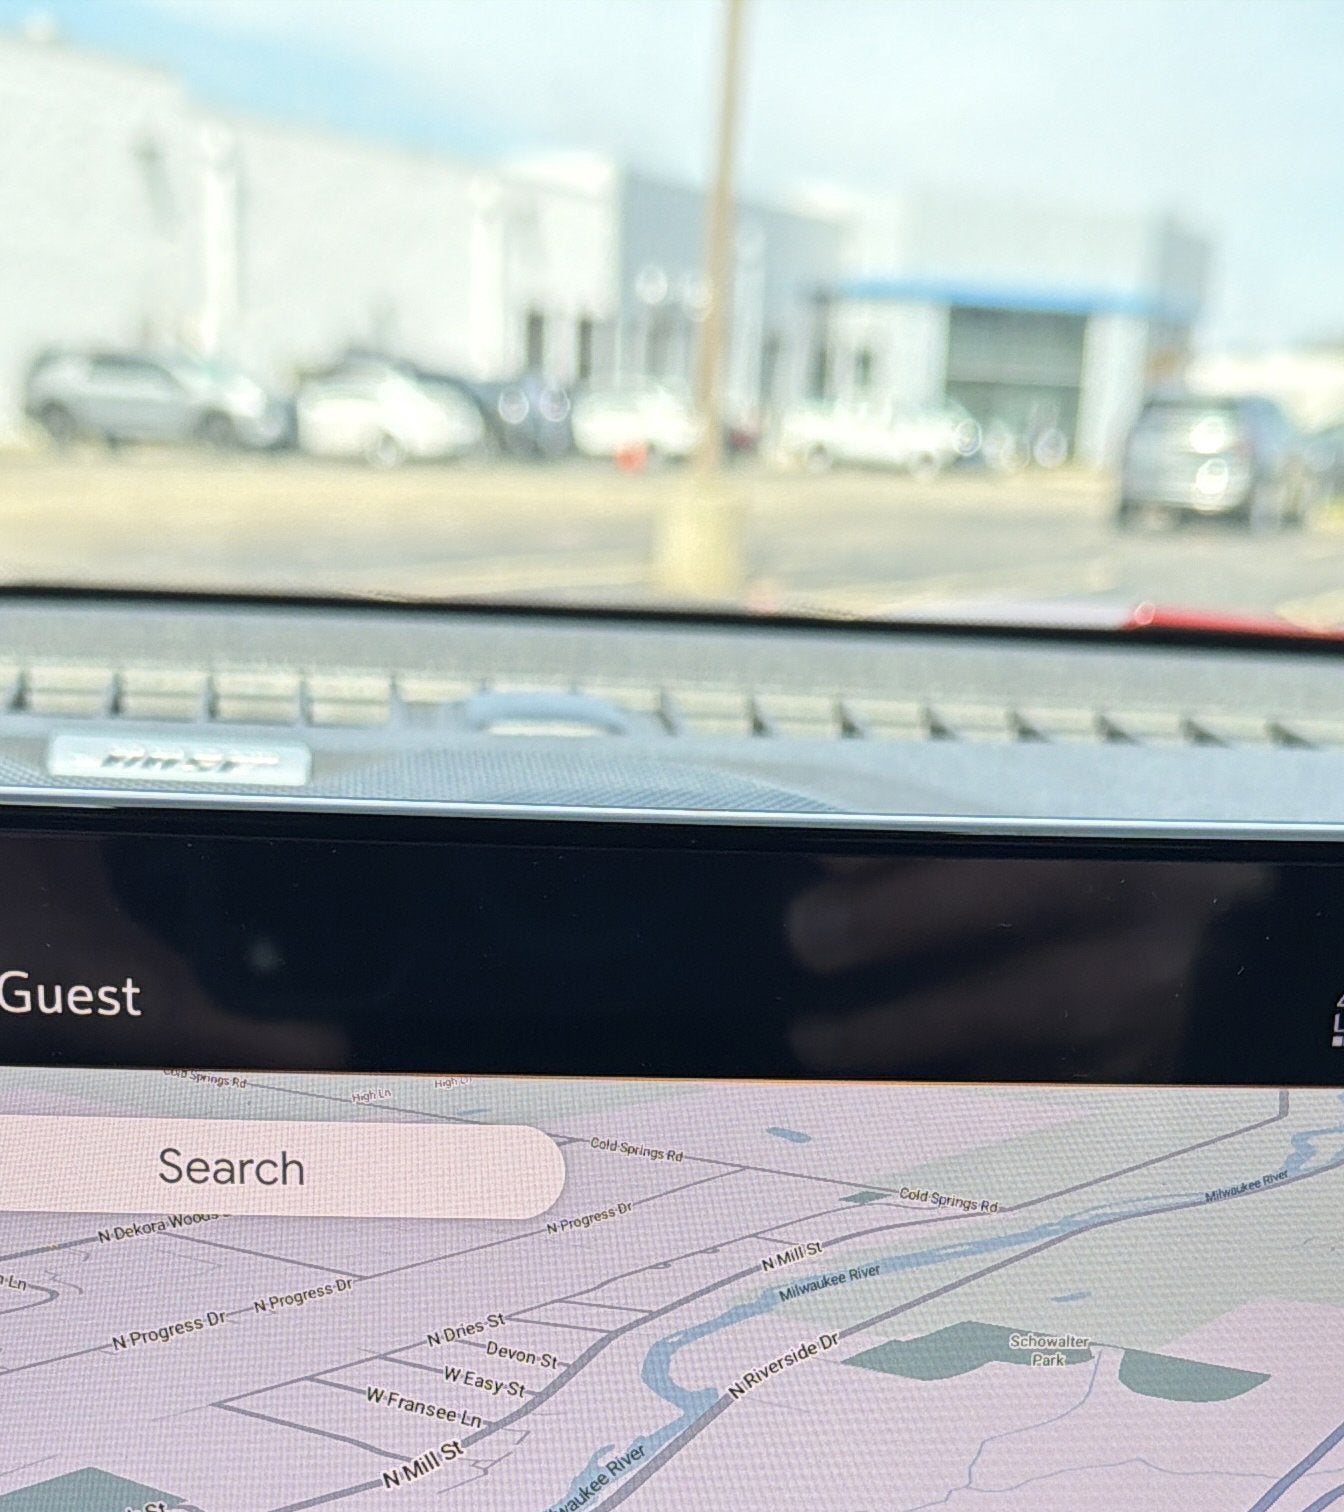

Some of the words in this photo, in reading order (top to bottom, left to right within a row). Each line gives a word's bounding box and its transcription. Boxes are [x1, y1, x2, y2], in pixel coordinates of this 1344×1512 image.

[190, 1070, 229, 1087] Springs
[232, 1077, 247, 1088] Rd
[591, 1137, 617, 1152] Cold
[620, 1142, 664, 1160] Springs
[666, 1150, 683, 1162] Rd
[159, 1147, 305, 1186] Search
[900, 1187, 928, 1204] Cold
[931, 1192, 978, 1212] Springs
[981, 1200, 997, 1213] Rd
[1205, 1178, 1261, 1203] Milwaukee
[1262, 1169, 1288, 1187] River
[98, 1230, 111, 1244] N
[113, 1219, 166, 1241] Dekora
[546, 1223, 558, 1235] N
[560, 1207, 616, 1232] Progress
[617, 1202, 632, 1215] Dr
[762, 1259, 775, 1272] N
[777, 1246, 805, 1268] Mill
[806, 1241, 822, 1256] St
[8, 1275, 27, 1291] Ln
[254, 1300, 267, 1313] N
[269, 1283, 334, 1310] Progress
[336, 1277, 353, 1292] Dr
[778, 1272, 846, 1302] Milwaukee
[848, 1264, 881, 1282] River
[112, 1336, 128, 1351] N
[130, 1317, 205, 1347] Progress
[207, 1310, 226, 1327] Dr
[427, 1332, 441, 1347] N
[443, 1321, 484, 1342] Dries
[487, 1313, 506, 1328] St
[1009, 1334, 1090, 1349] Schowalter
[486, 1340, 536, 1364] Devon
[540, 1353, 558, 1369] St
[728, 1383, 744, 1400] N
[741, 1344, 818, 1391] Riverside
[818, 1331, 840, 1351] Dr
[1032, 1353, 1064, 1367] Park
[444, 1366, 461, 1382] W
[463, 1371, 504, 1396] Easy
[506, 1381, 526, 1398] St
[367, 1386, 386, 1403] W
[387, 1392, 457, 1423] Fransee
[460, 1411, 482, 1429] Ln
[382, 1471, 400, 1489] N
[401, 1451, 441, 1482] Mill
[441, 1440, 465, 1461] St
[607, 1443, 645, 1478] River
